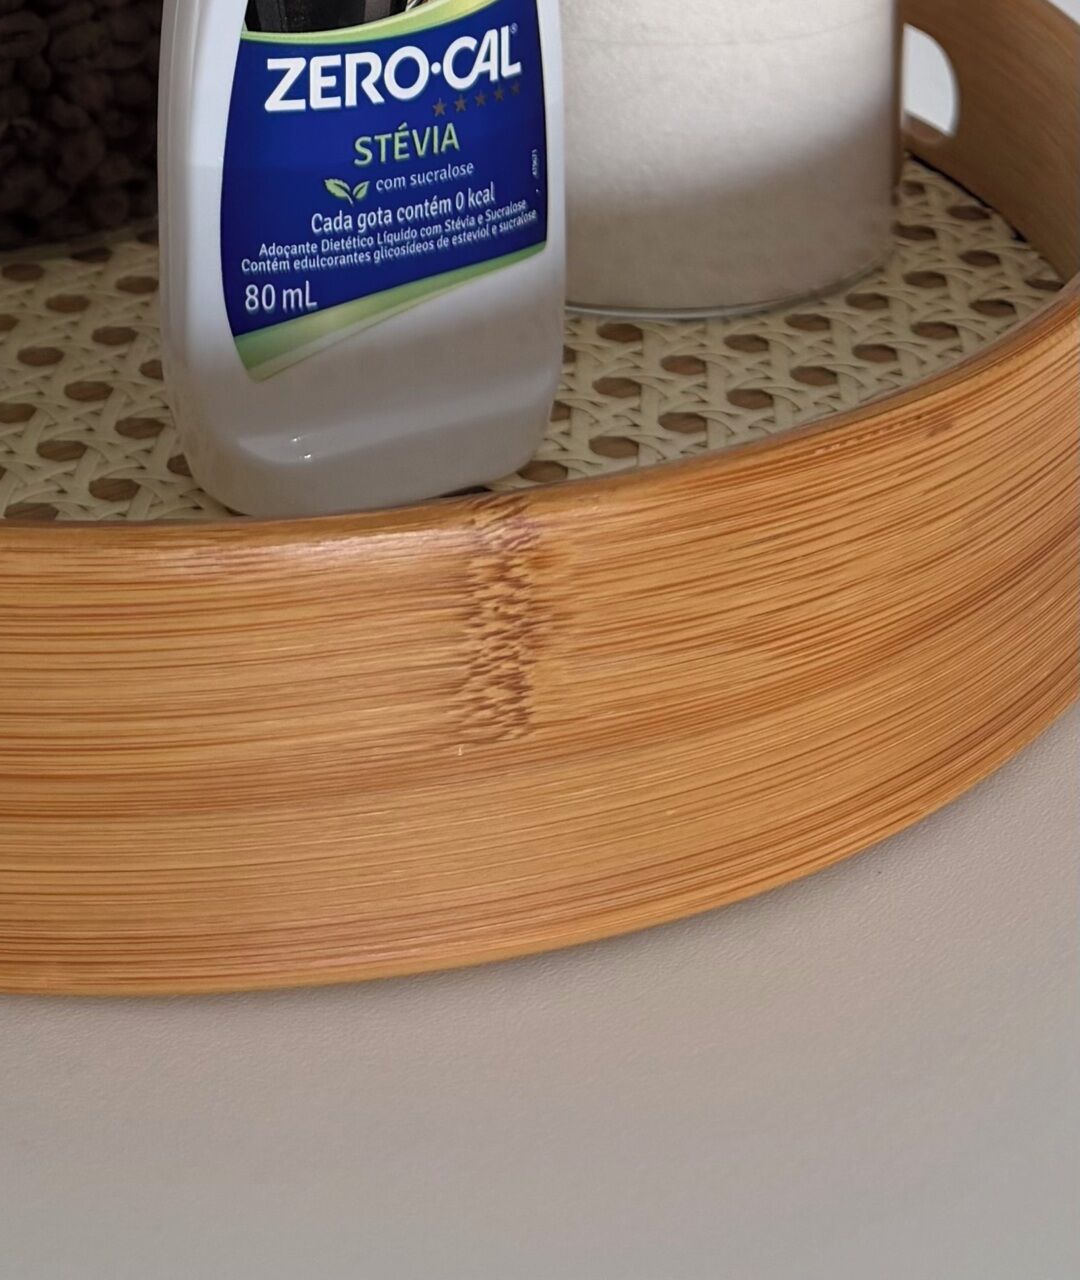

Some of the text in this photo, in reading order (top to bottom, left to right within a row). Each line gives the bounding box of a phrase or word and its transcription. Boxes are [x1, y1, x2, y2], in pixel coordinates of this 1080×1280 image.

[353, 122, 460, 167] STÉVIA
[375, 162, 474, 192] com sucralose
[258, 199, 527, 259] Adoçante Dietético Líquido com Stévia e Sucralose
[311, 181, 495, 234] Cada gota contém 0 kcal
[241, 209, 538, 273] Contém edulcorantes glicosídeos de esteviol e sucralose
[245, 280, 318, 311] 80 mL
